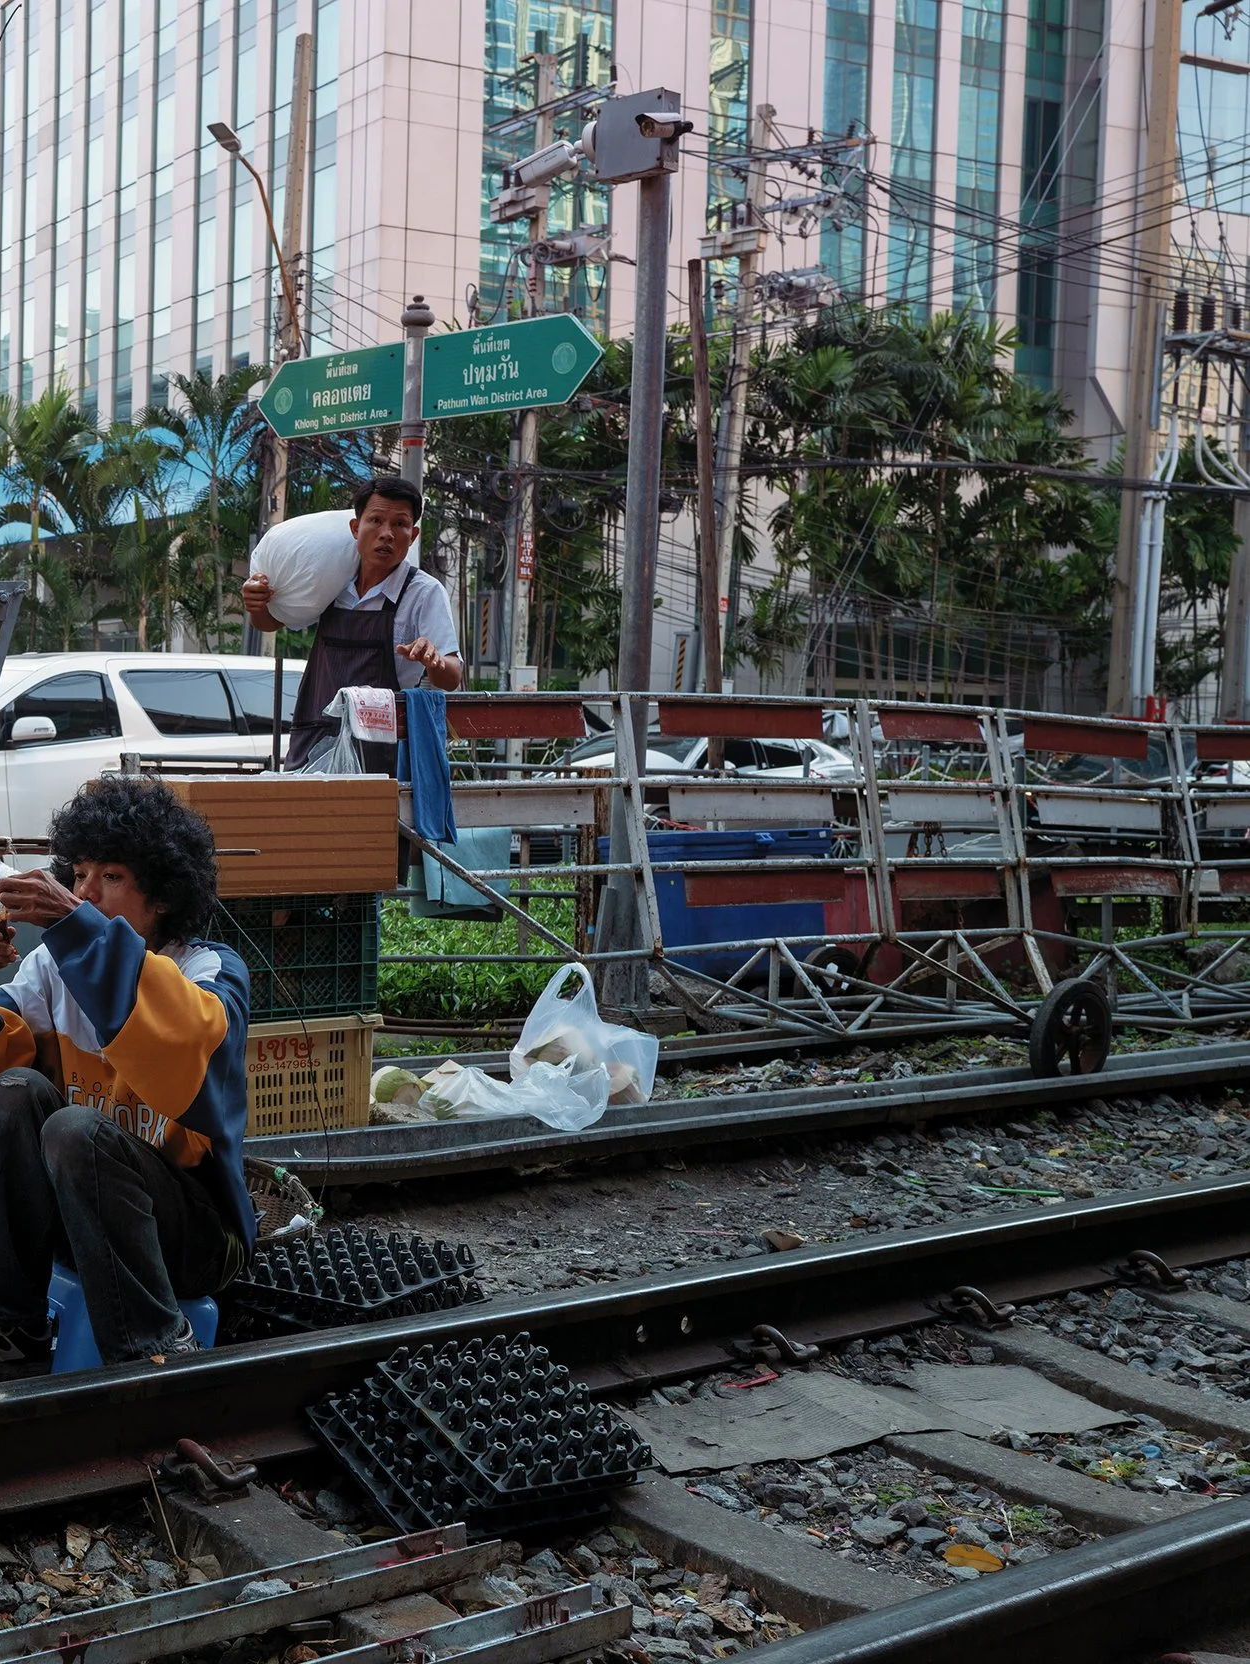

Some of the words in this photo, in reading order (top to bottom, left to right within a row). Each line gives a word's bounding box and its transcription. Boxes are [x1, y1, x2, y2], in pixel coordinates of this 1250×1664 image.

[472, 332, 510, 355] พื้นที่เขต
[326, 357, 358, 379] พื้นที่เขต
[462, 354, 519, 391] ปทุมวัน
[312, 383, 371, 408] คลองเตย
[437, 398, 468, 411] Pathum
[470, 395, 488, 406] Wan
[491, 390, 523, 404] District
[526, 387, 548, 399] Area
[294, 419, 319, 430] Khlong
[322, 414, 336, 426] Toei
[340, 411, 367, 423] District
[370, 408, 388, 419] Area
